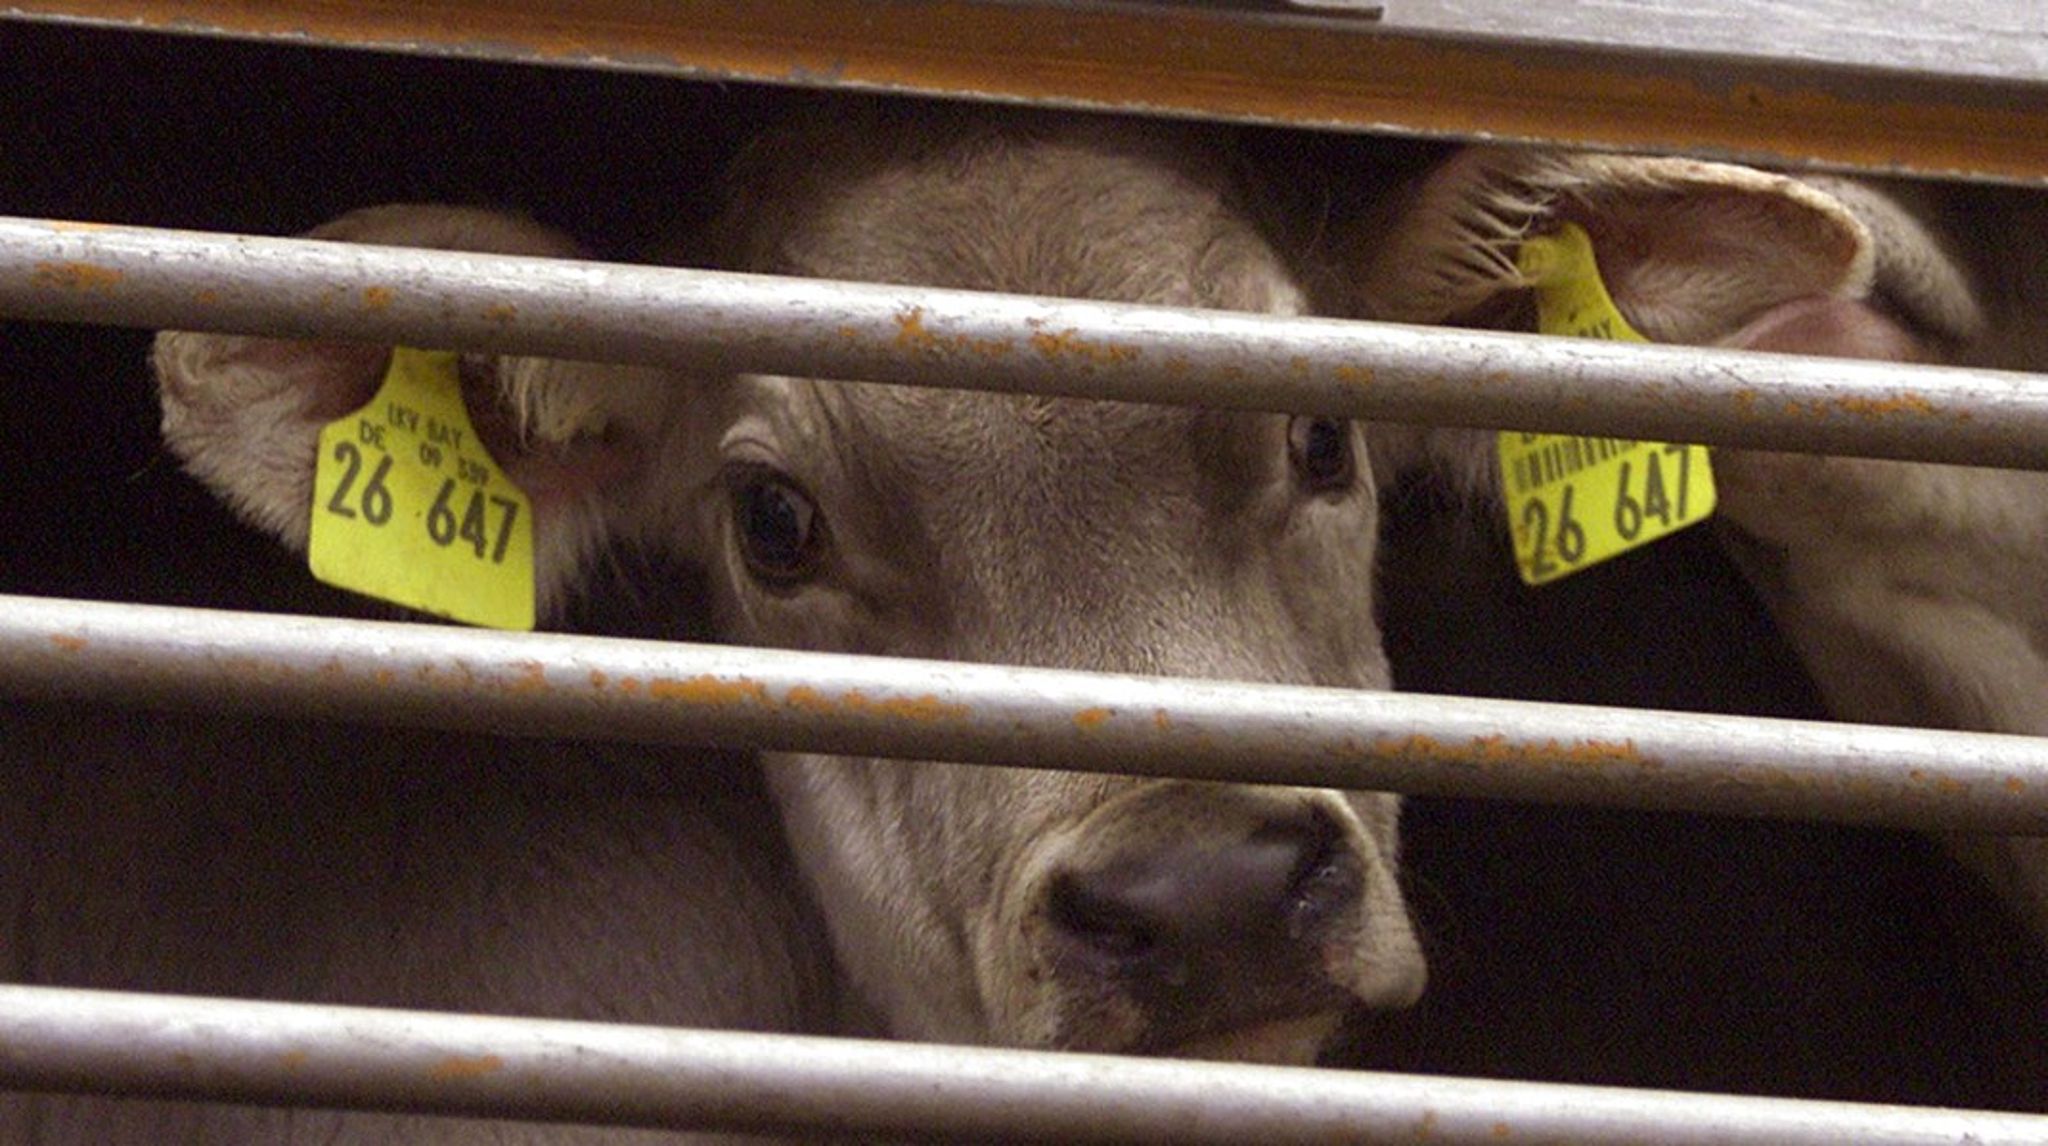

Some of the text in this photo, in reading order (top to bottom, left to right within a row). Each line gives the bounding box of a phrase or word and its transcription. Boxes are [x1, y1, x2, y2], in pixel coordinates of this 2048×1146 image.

[360, 419, 387, 450] DE
[327, 441, 520, 564] 26 647
[1523, 443, 1690, 577] 26 647
